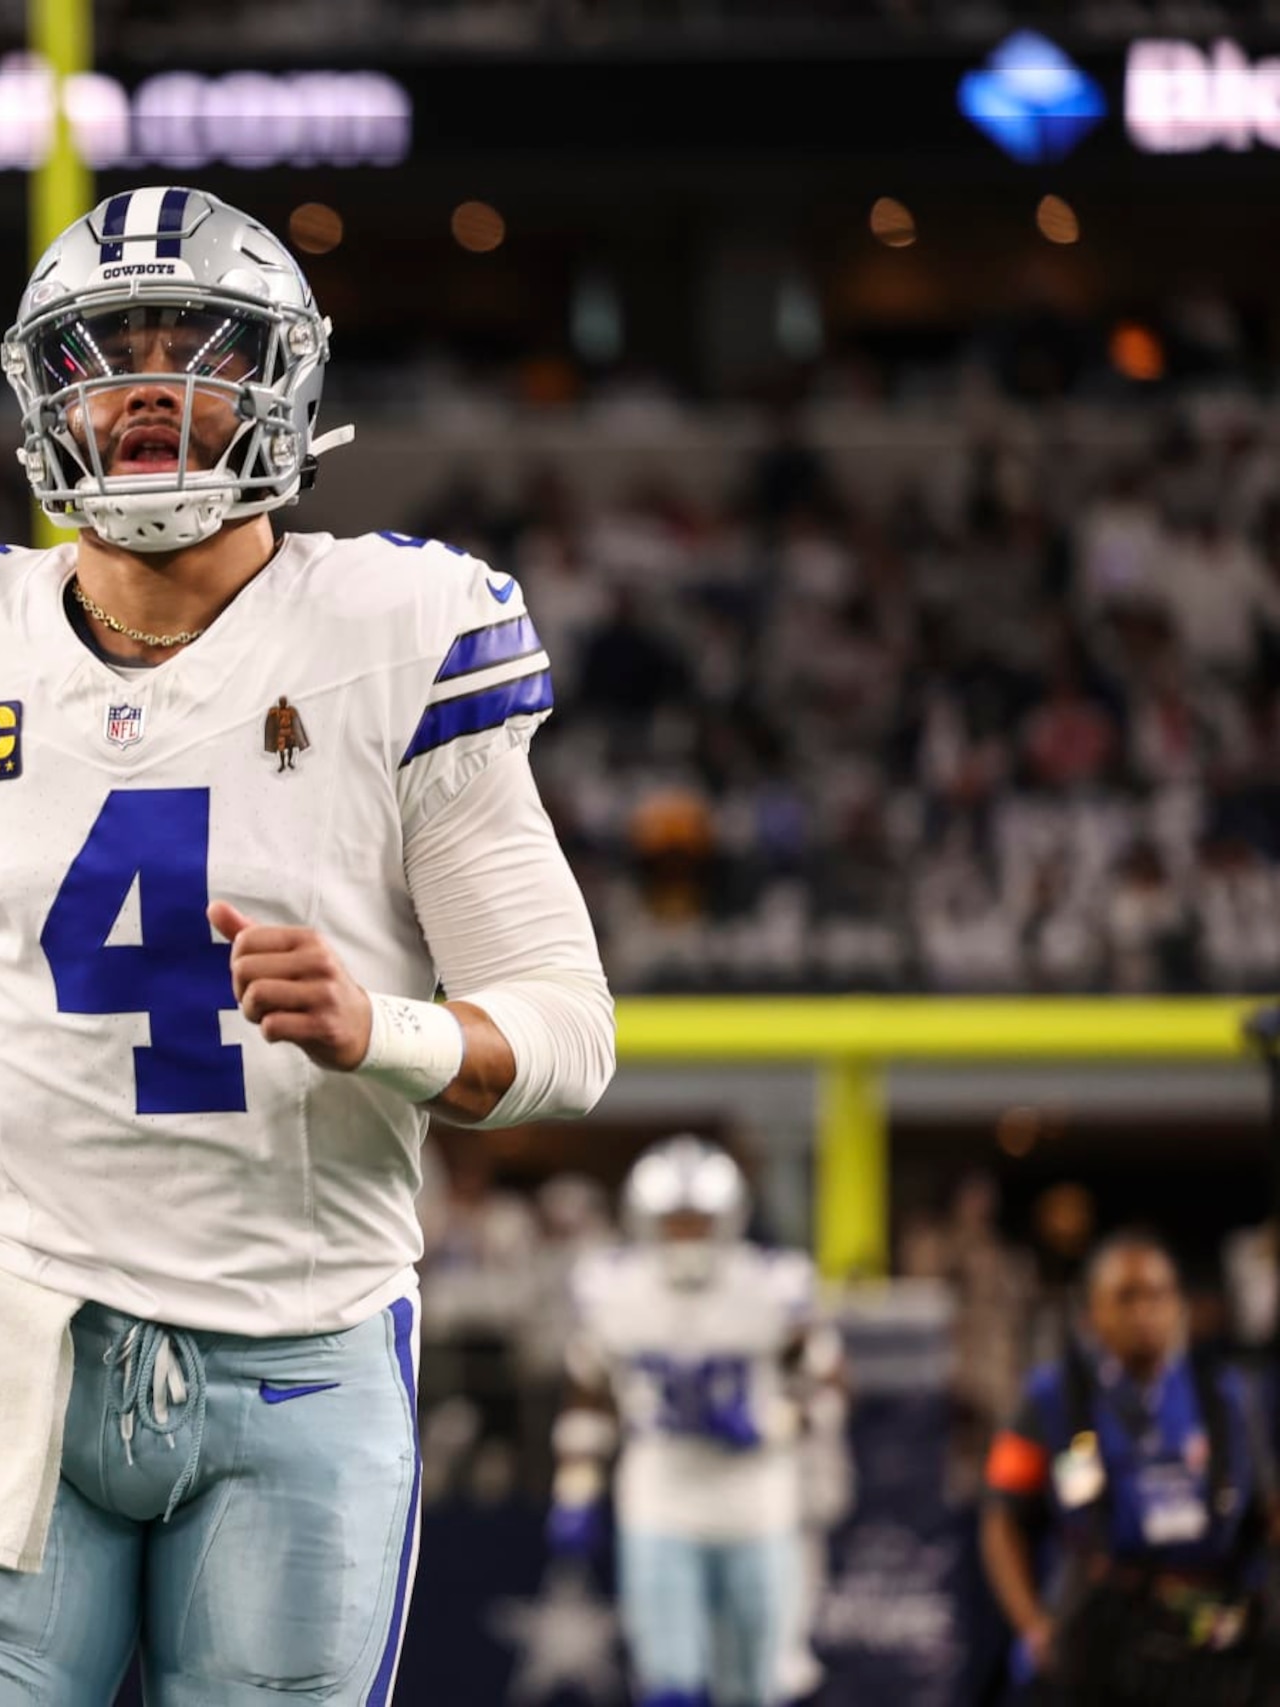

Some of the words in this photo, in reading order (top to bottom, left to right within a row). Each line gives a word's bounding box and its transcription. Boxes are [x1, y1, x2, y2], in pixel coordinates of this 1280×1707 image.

[103, 264, 176, 280] COWBOYS
[110, 720, 137, 739] NFL
[39, 786, 248, 1116] 4
